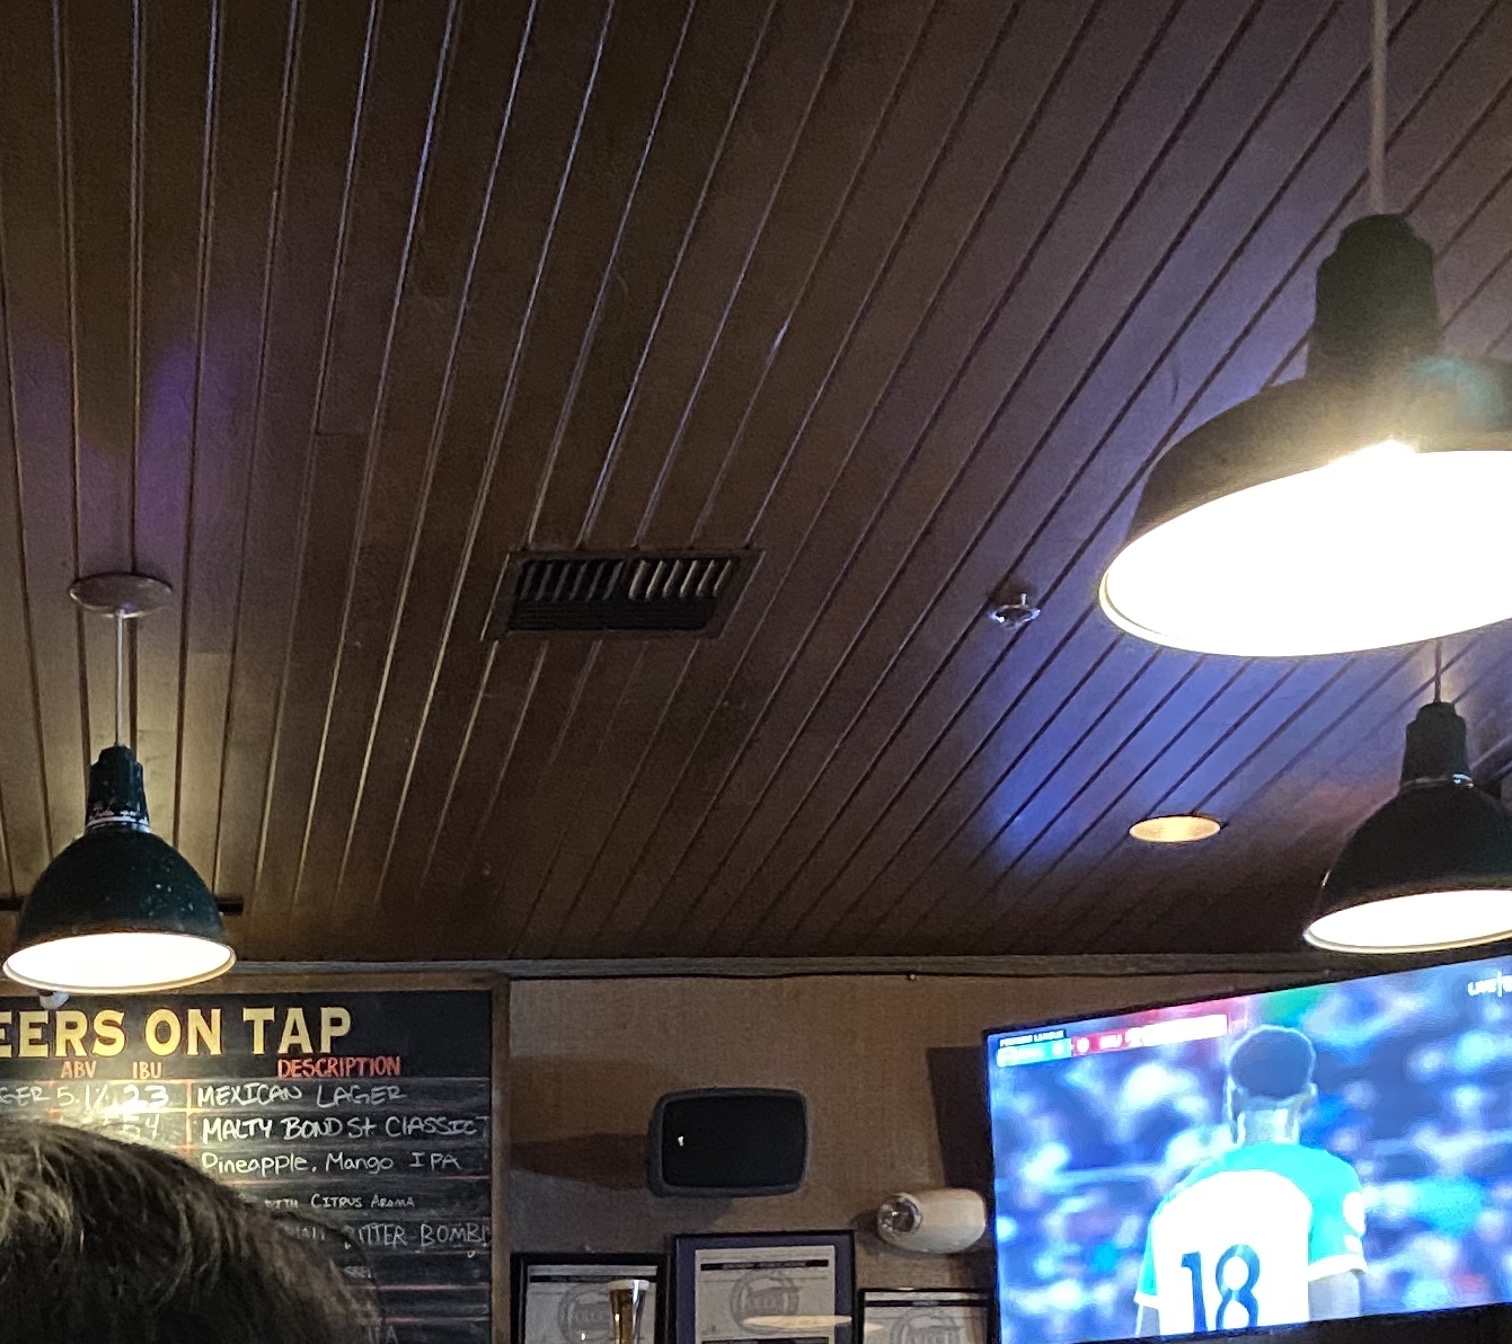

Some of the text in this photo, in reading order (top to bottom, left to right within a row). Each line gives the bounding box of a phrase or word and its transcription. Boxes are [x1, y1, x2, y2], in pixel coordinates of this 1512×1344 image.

[144, 1007, 222, 1057] ON
[242, 1006, 352, 1055] TAP
[60, 1060, 97, 1079] ABV
[132, 1061, 162, 1079] IBU
[277, 1055, 402, 1079] DESCRIPTION
[197, 1084, 302, 1108] MEXICAN
[316, 1085, 407, 1108] LAGER
[201, 1117, 274, 1145] MALTY
[280, 1116, 342, 1140] BOND
[325, 1151, 394, 1175] Mango
[343, 1223, 408, 1248] ITTER
